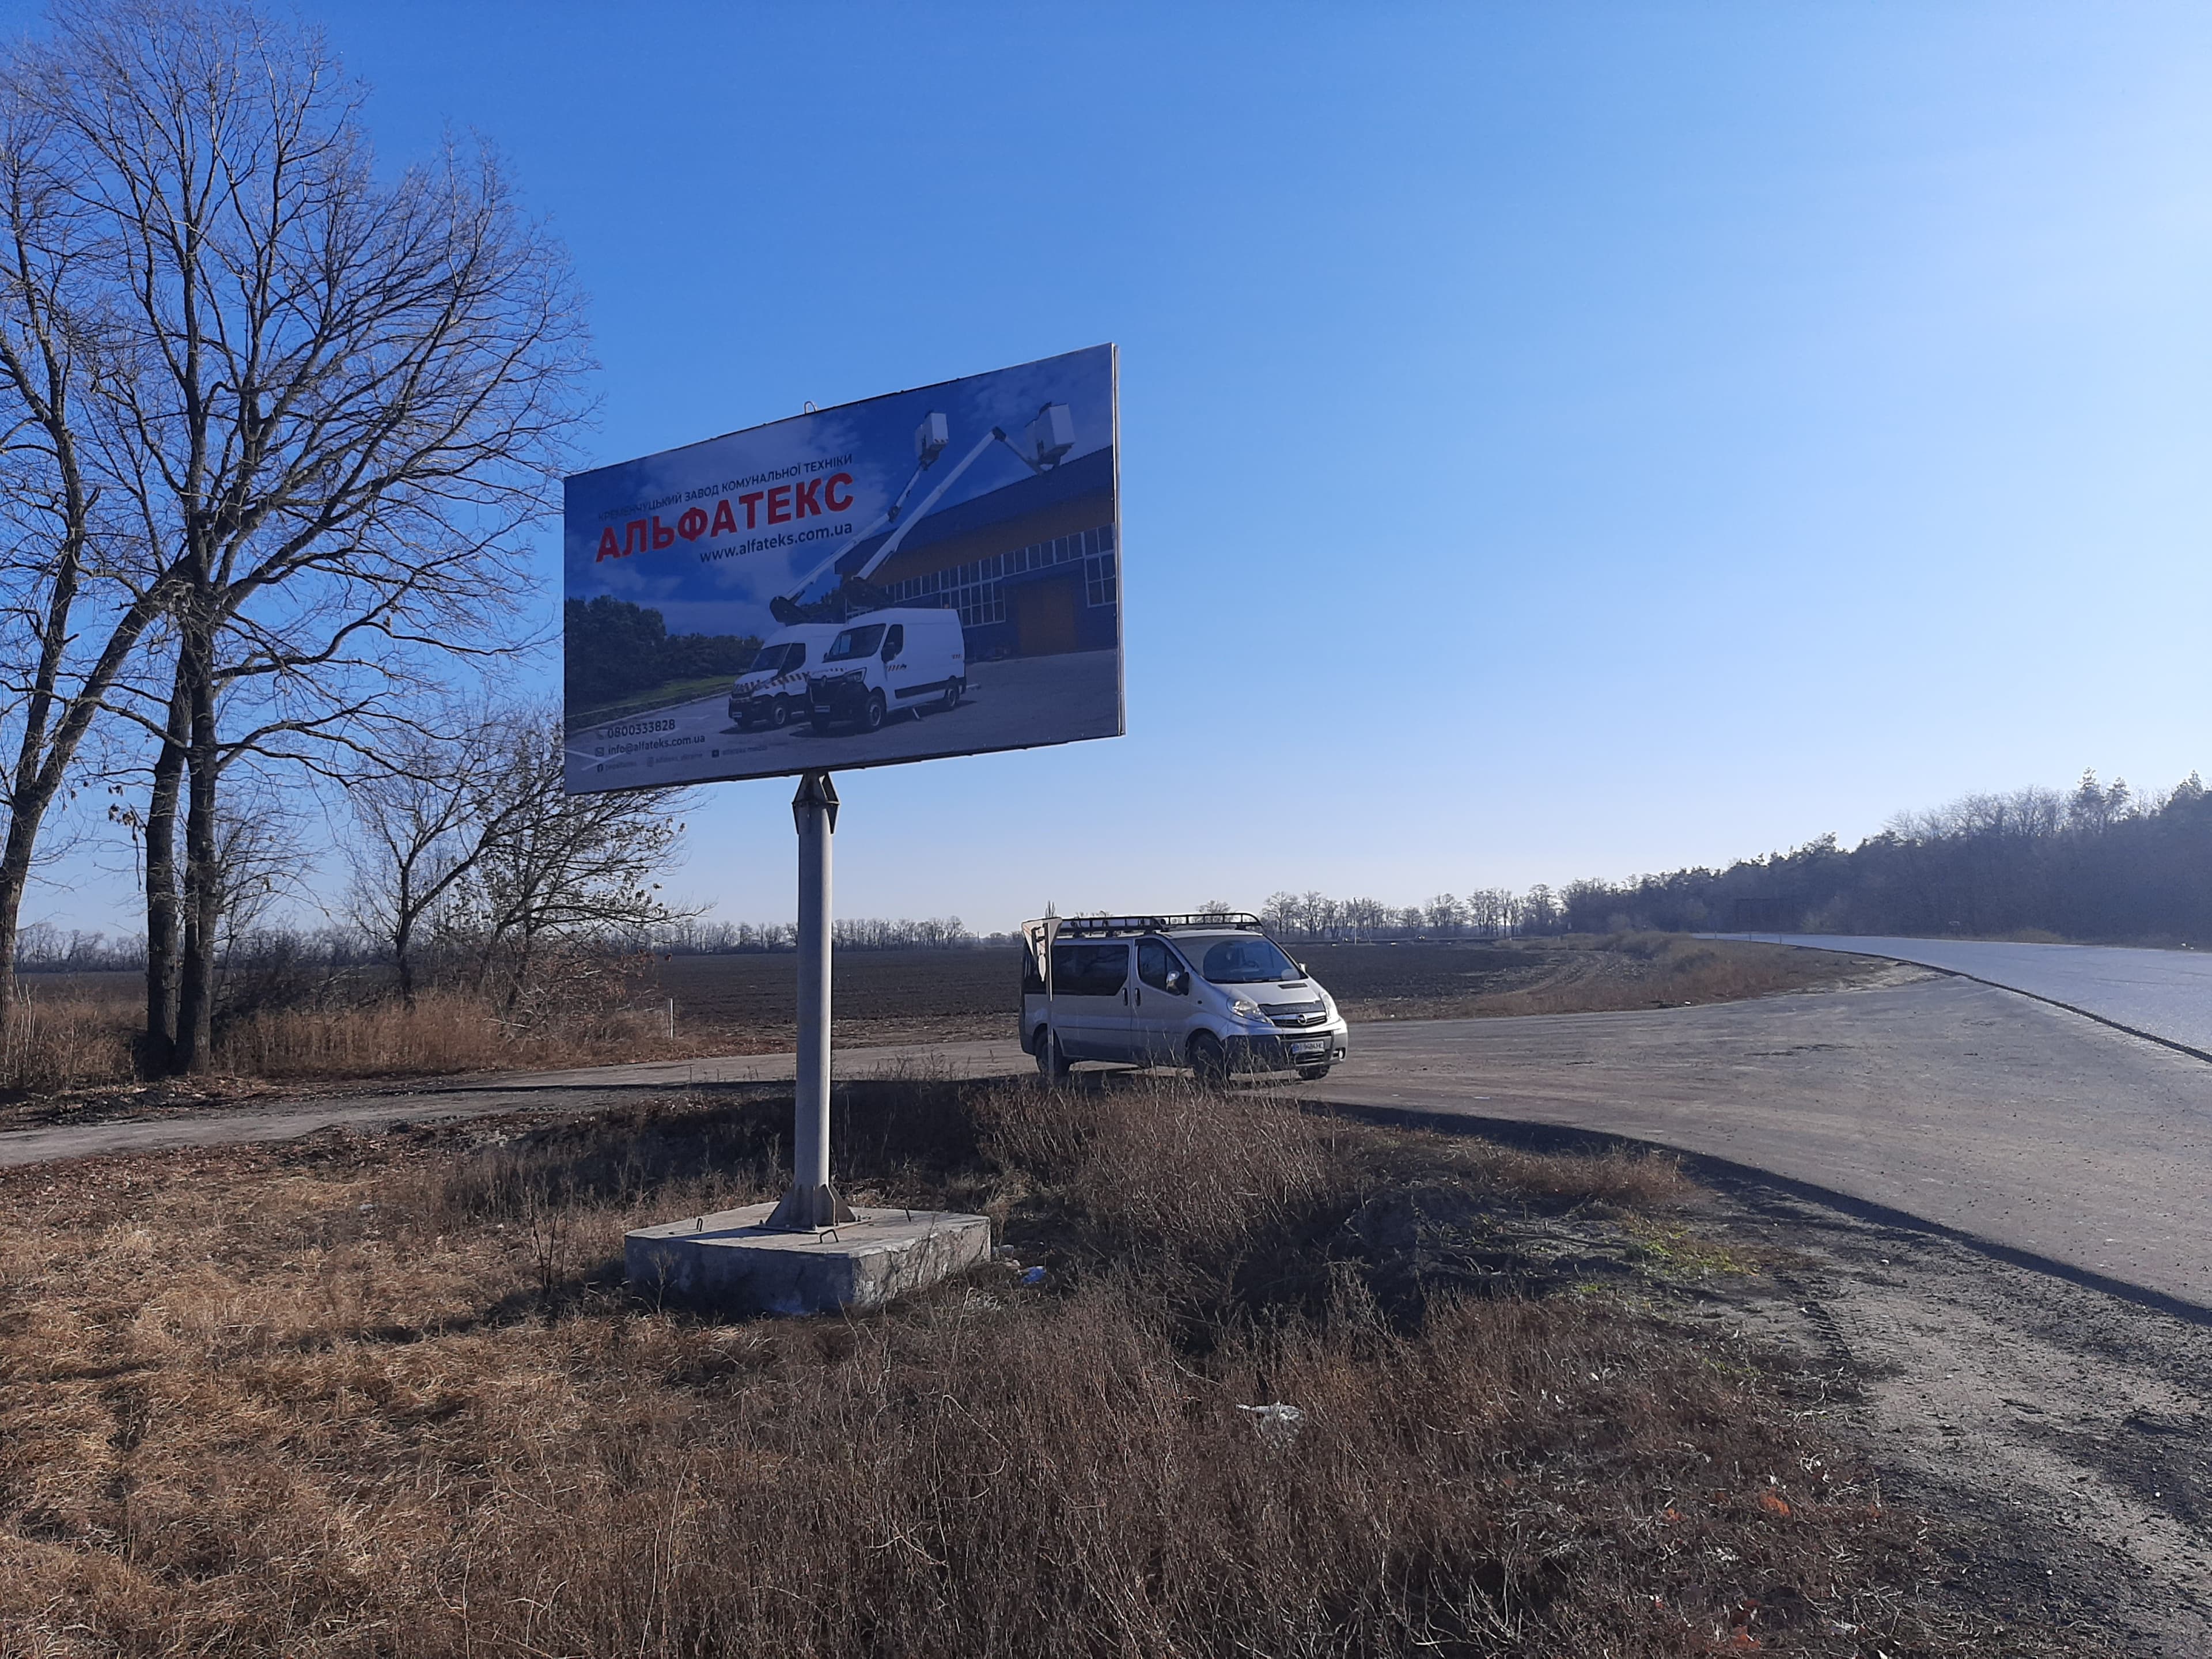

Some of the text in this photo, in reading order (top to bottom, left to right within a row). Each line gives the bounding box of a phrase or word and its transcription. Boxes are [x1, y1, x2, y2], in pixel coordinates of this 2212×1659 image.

[684, 485, 719, 502] ЗАВОД
[721, 461, 801, 493] КОМУНАЛЬНОЇ
[804, 453, 853, 473] ТЕХНІКИ
[596, 472, 854, 563] АЛЬФАТЕКС
[699, 522, 853, 563] www.alfateks.com.ua
[607, 718, 676, 739] 0800333828
